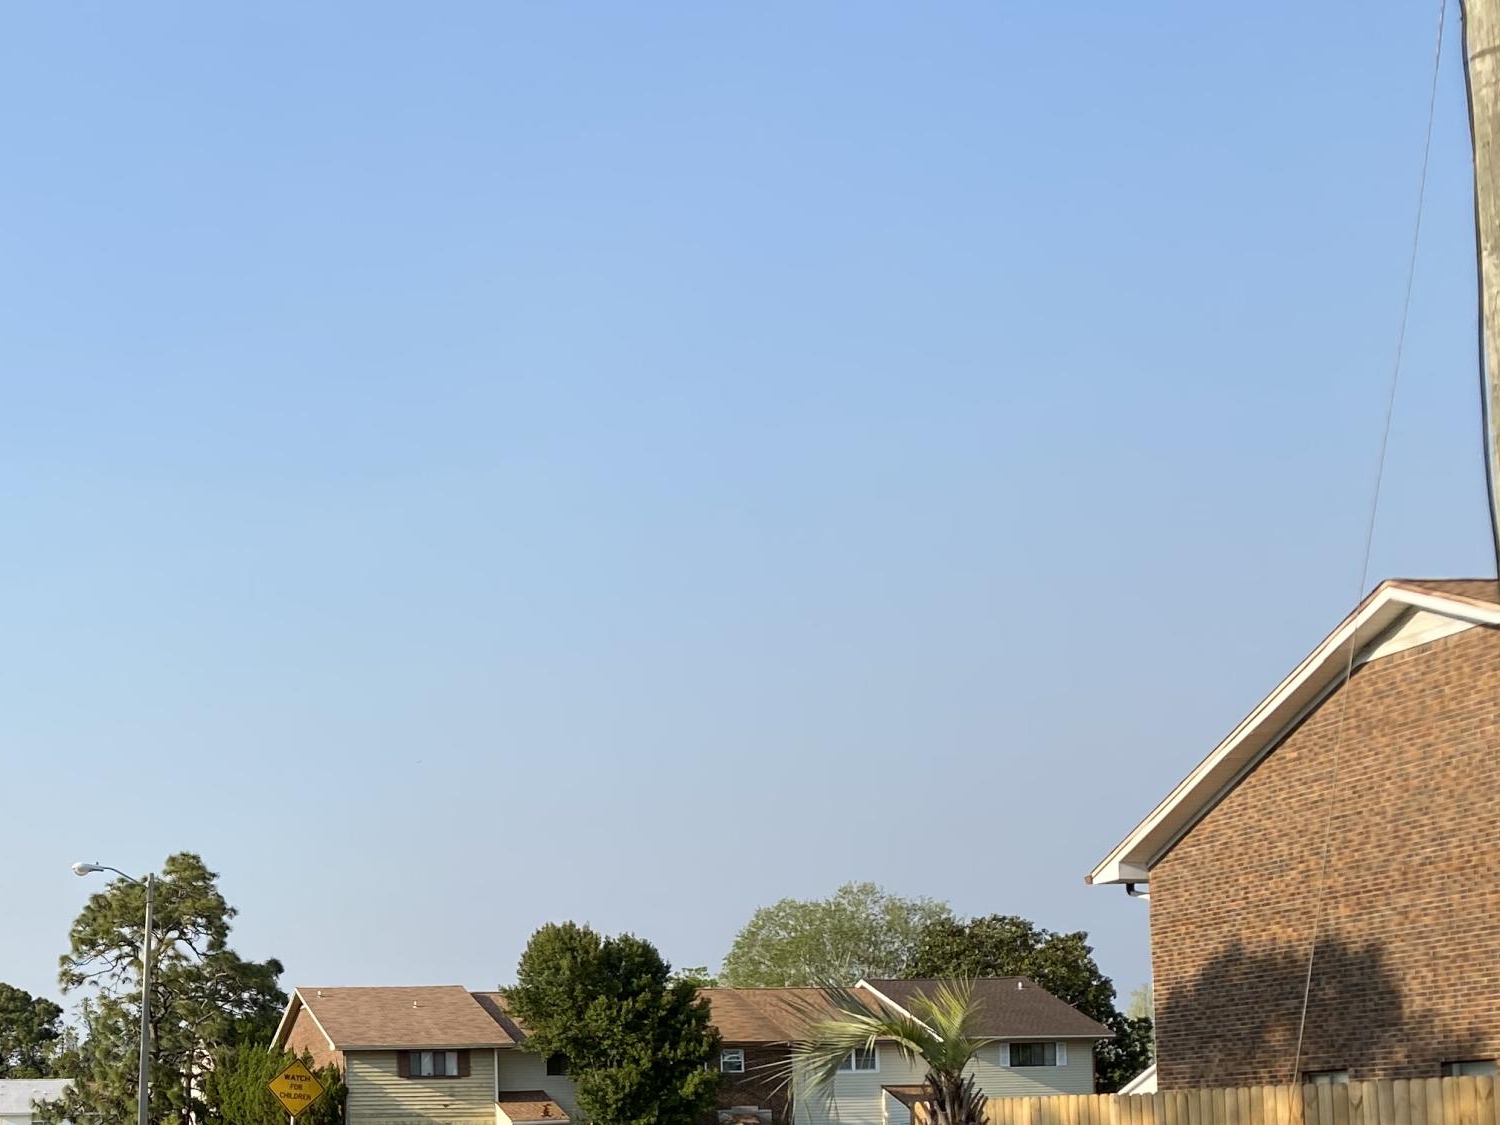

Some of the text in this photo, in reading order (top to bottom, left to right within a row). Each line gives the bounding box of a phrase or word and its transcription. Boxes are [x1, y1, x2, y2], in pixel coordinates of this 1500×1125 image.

[284, 1073, 311, 1082] WATCH
[290, 1083, 303, 1091] FOR
[279, 1092, 311, 1101] CHILDREN
